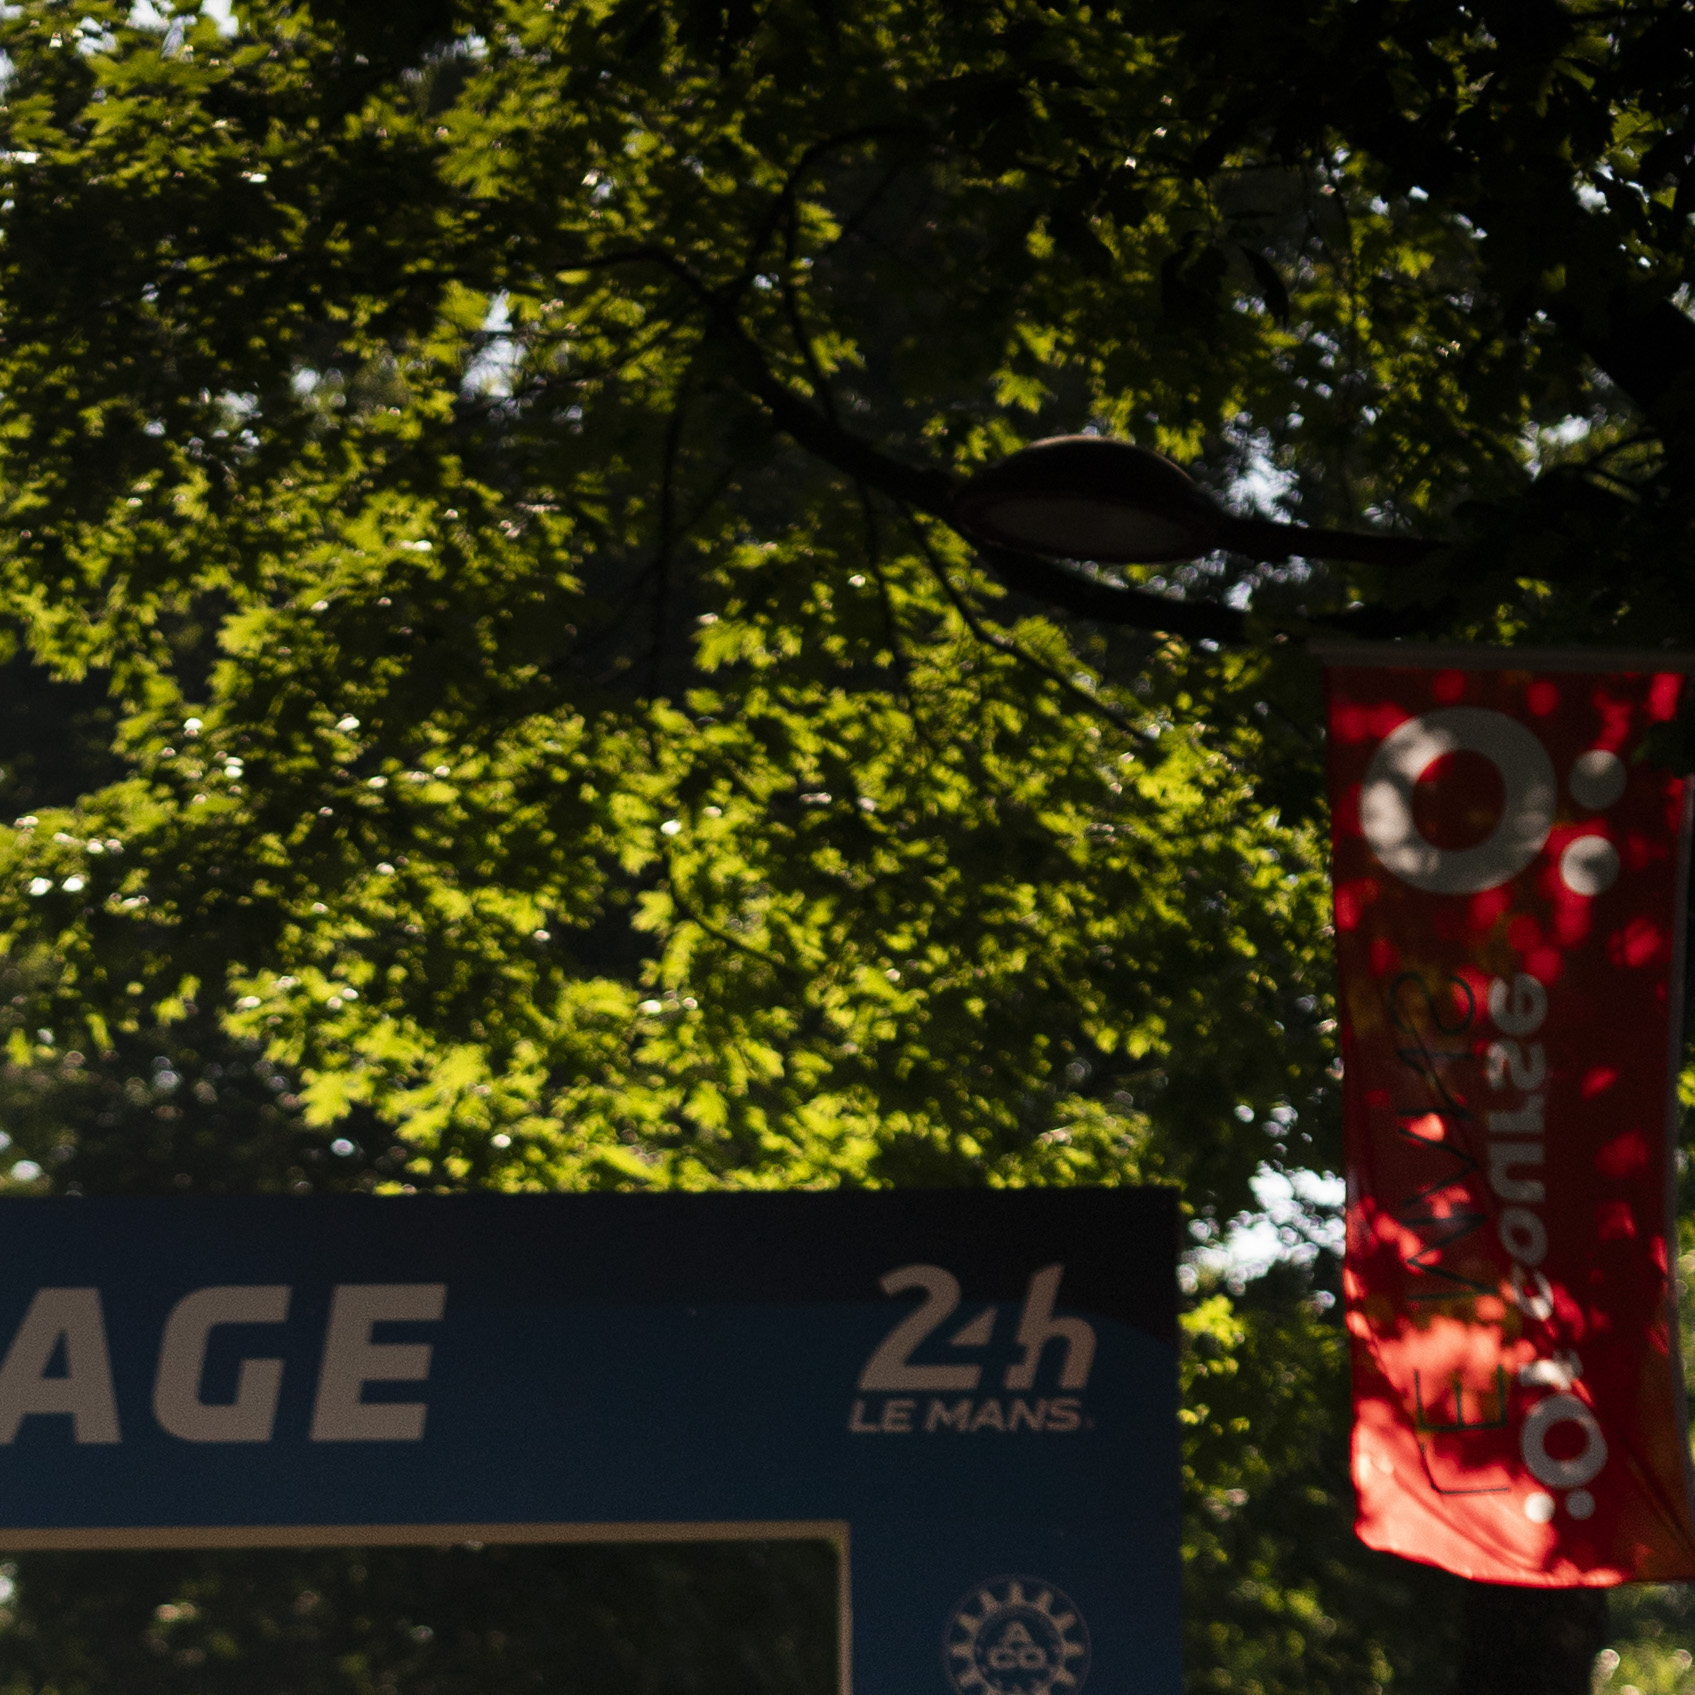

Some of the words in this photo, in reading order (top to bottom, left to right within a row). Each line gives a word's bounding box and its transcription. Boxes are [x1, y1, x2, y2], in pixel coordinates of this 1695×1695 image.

[857, 1261, 1098, 1392] 24h
[847, 1398, 914, 1434] LE
[924, 1396, 1084, 1433] MANS
